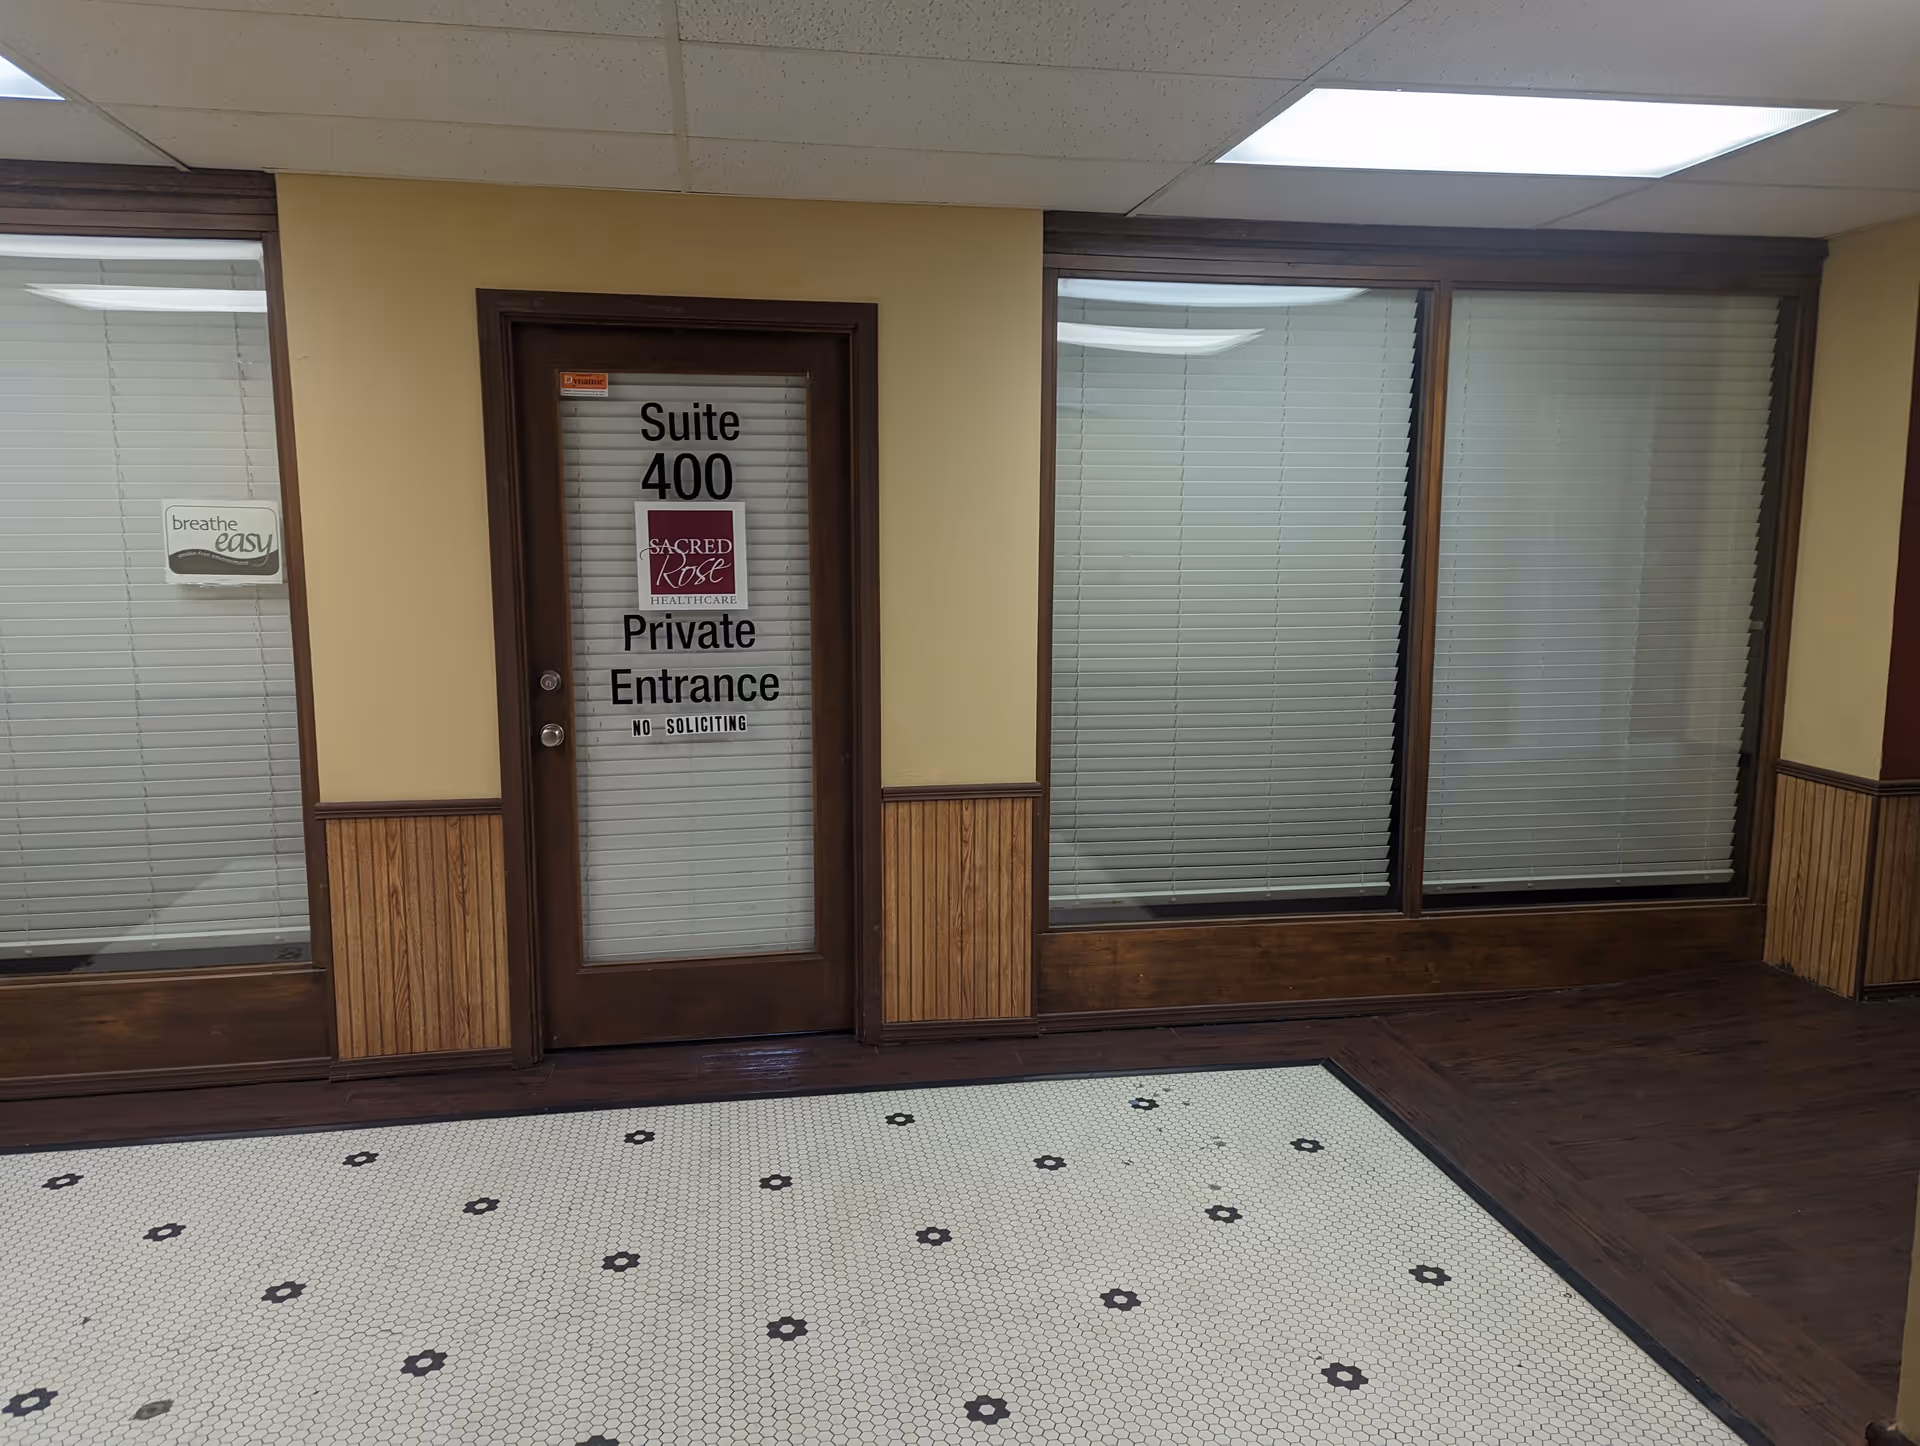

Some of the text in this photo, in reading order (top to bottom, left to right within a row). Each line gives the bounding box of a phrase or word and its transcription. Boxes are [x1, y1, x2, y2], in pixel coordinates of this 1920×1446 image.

[564, 375, 605, 387] Dynamic
[641, 402, 740, 441] Suite
[641, 453, 732, 501] 400
[172, 514, 238, 531] breathe
[214, 532, 273, 565] easy
[649, 538, 733, 555] SACRED
[641, 545, 732, 588] Rose
[650, 595, 738, 605] HEALTHCARE
[623, 613, 756, 651] Private
[611, 669, 780, 705] Entrance
[632, 715, 747, 737] NO SOLICITING
